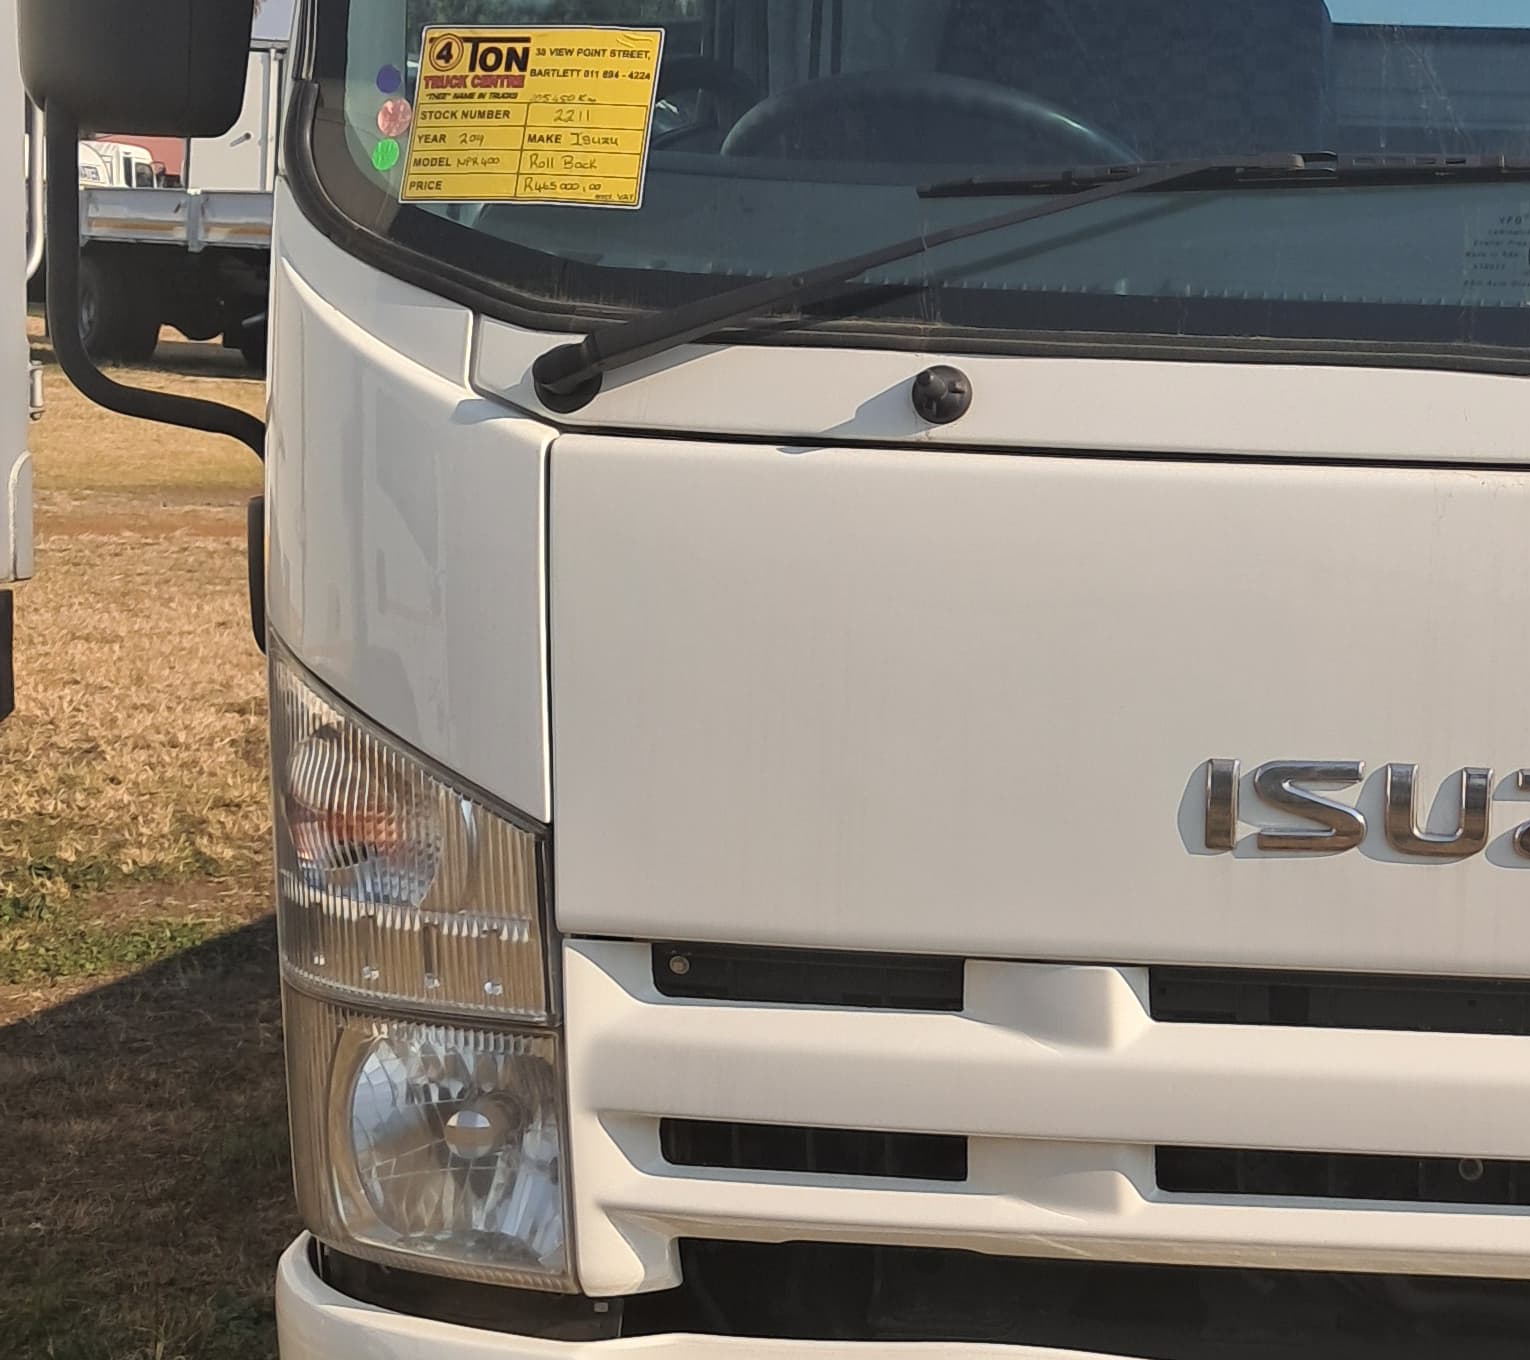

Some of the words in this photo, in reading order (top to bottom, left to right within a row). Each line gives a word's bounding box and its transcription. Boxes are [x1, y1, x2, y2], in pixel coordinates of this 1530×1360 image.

[461, 36, 531, 73] TON
[550, 47, 575, 57] VIEW
[577, 48, 608, 58] POINT
[530, 68, 583, 78] BARTLETT
[423, 74, 469, 89] TRUCK
[420, 110, 458, 121] STOCK
[460, 109, 511, 120] NUMBER
[417, 133, 447, 144] YEAR
[527, 133, 562, 144] MAKE
[412, 157, 452, 168] MODEL
[408, 180, 443, 191] PRICE
